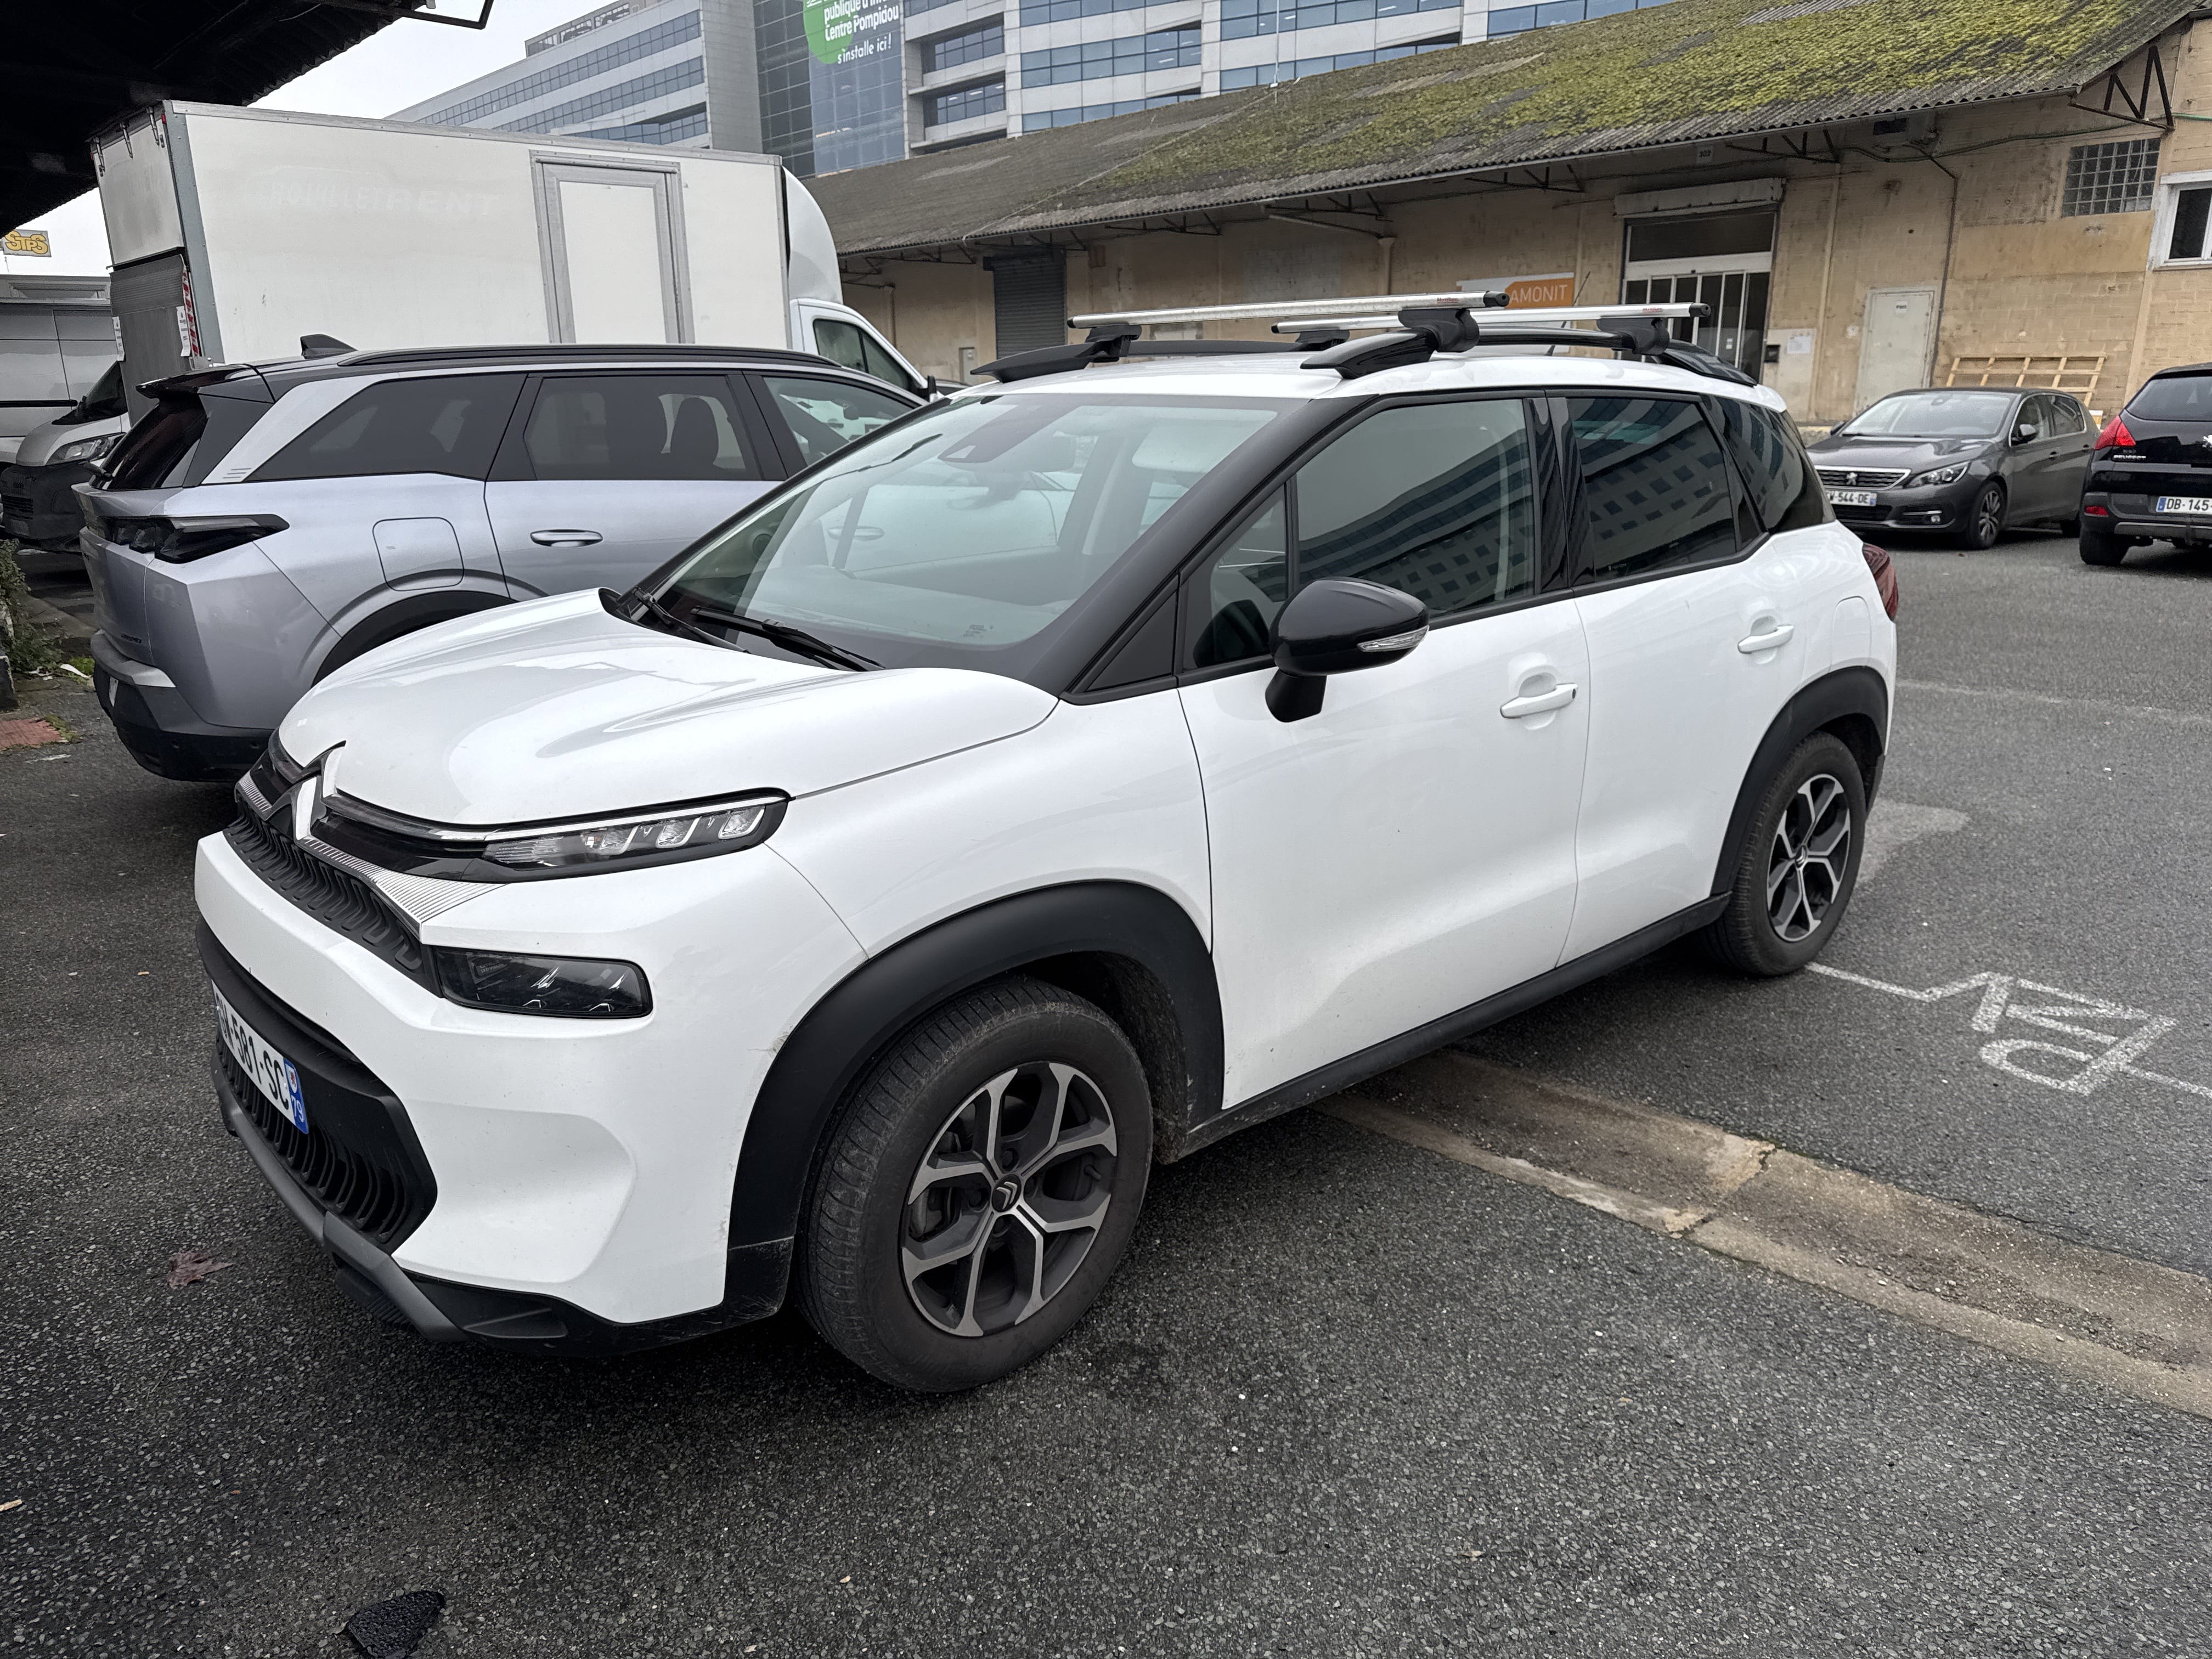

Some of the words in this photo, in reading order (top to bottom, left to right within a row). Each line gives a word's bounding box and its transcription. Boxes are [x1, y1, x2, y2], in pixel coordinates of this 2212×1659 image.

[825, 20, 853, 41] Centre
[853, 5, 899, 32] Pompidou
[4, 230, 49, 255] STPS
[290, 1095, 305, 1122] 79
